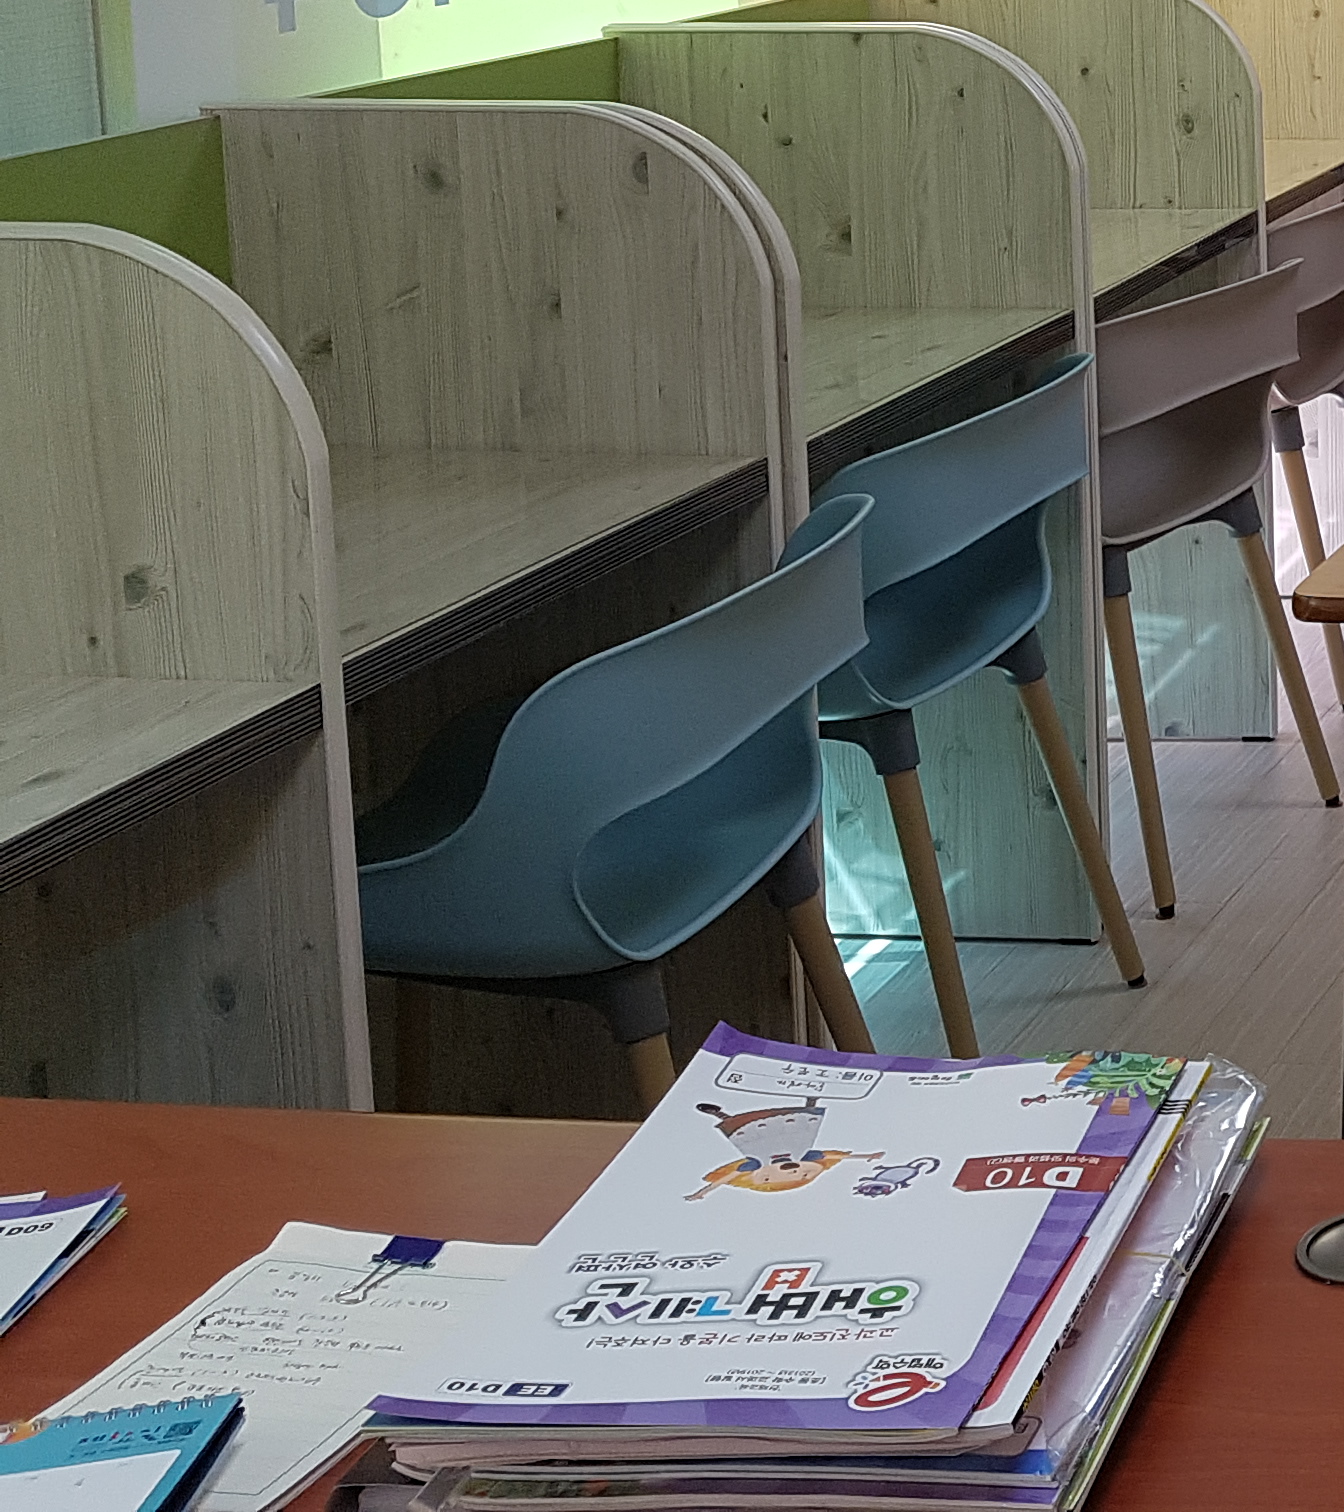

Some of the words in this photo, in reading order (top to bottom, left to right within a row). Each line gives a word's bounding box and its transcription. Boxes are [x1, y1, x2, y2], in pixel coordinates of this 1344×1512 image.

[834, 1070, 873, 1081] 이름:
[984, 1165, 1083, 1187] D10
[5, 1222, 54, 1236] D09
[572, 1251, 658, 1272] 연산편
[664, 1254, 725, 1268] 수와
[677, 1331, 741, 1345] 기본을
[744, 1331, 788, 1344] 따라
[791, 1327, 850, 1342] 진도에
[854, 1326, 899, 1339] 교과
[585, 1334, 671, 1348] 다져주는!
[871, 1355, 943, 1369] 해법수학
[445, 1379, 502, 1393] D10
